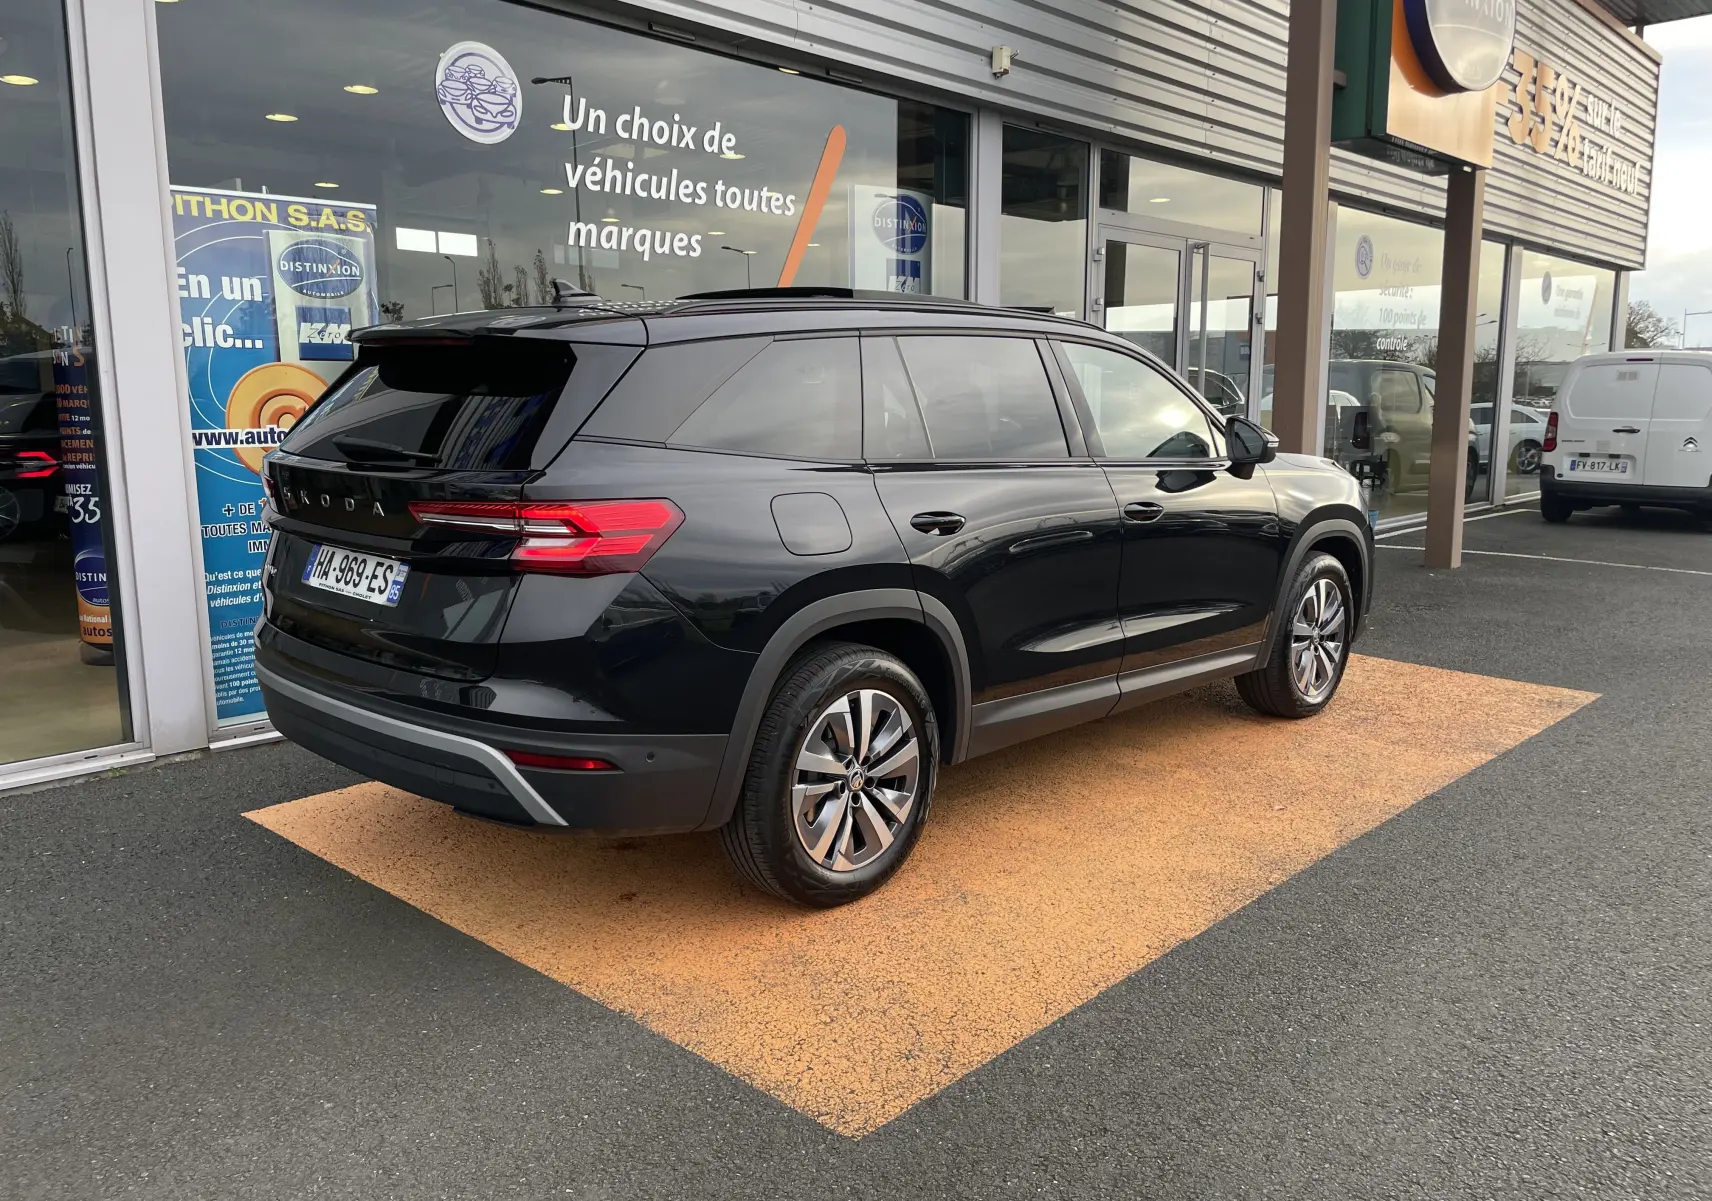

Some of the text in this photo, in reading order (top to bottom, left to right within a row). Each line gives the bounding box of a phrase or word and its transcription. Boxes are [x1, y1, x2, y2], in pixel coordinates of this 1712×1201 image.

[563, 95, 736, 156] Un choix de
[1587, 94, 1608, 129] sur
[1609, 104, 1621, 138] le
[1583, 138, 1641, 195] tarif neuf
[565, 157, 796, 216] véhicules toutes
[287, 204, 373, 233] S.A.S.
[875, 217, 927, 233] DISTINXION
[568, 221, 702, 261] marques
[280, 258, 360, 277] DISTINXION
[176, 267, 263, 301] En un
[1393, 308, 1416, 327] points
[181, 317, 264, 349] clic...
[299, 322, 352, 344] KM
[1376, 335, 1408, 351] contrôle
[1576, 460, 1621, 471] FV-817-LK
[239, 503, 255, 516] DE
[202, 523, 246, 538] TOUTES
[204, 571, 232, 582] Qu'est
[234, 570, 244, 579] ce
[246, 568, 262, 579] que
[313, 548, 394, 596] HA-969-ES
[207, 581, 262, 594] Distinxion et
[388, 584, 401, 600] 85
[210, 594, 251, 607] véhicules
[83, 626, 113, 637] autos
[220, 616, 259, 628] DISTIN
